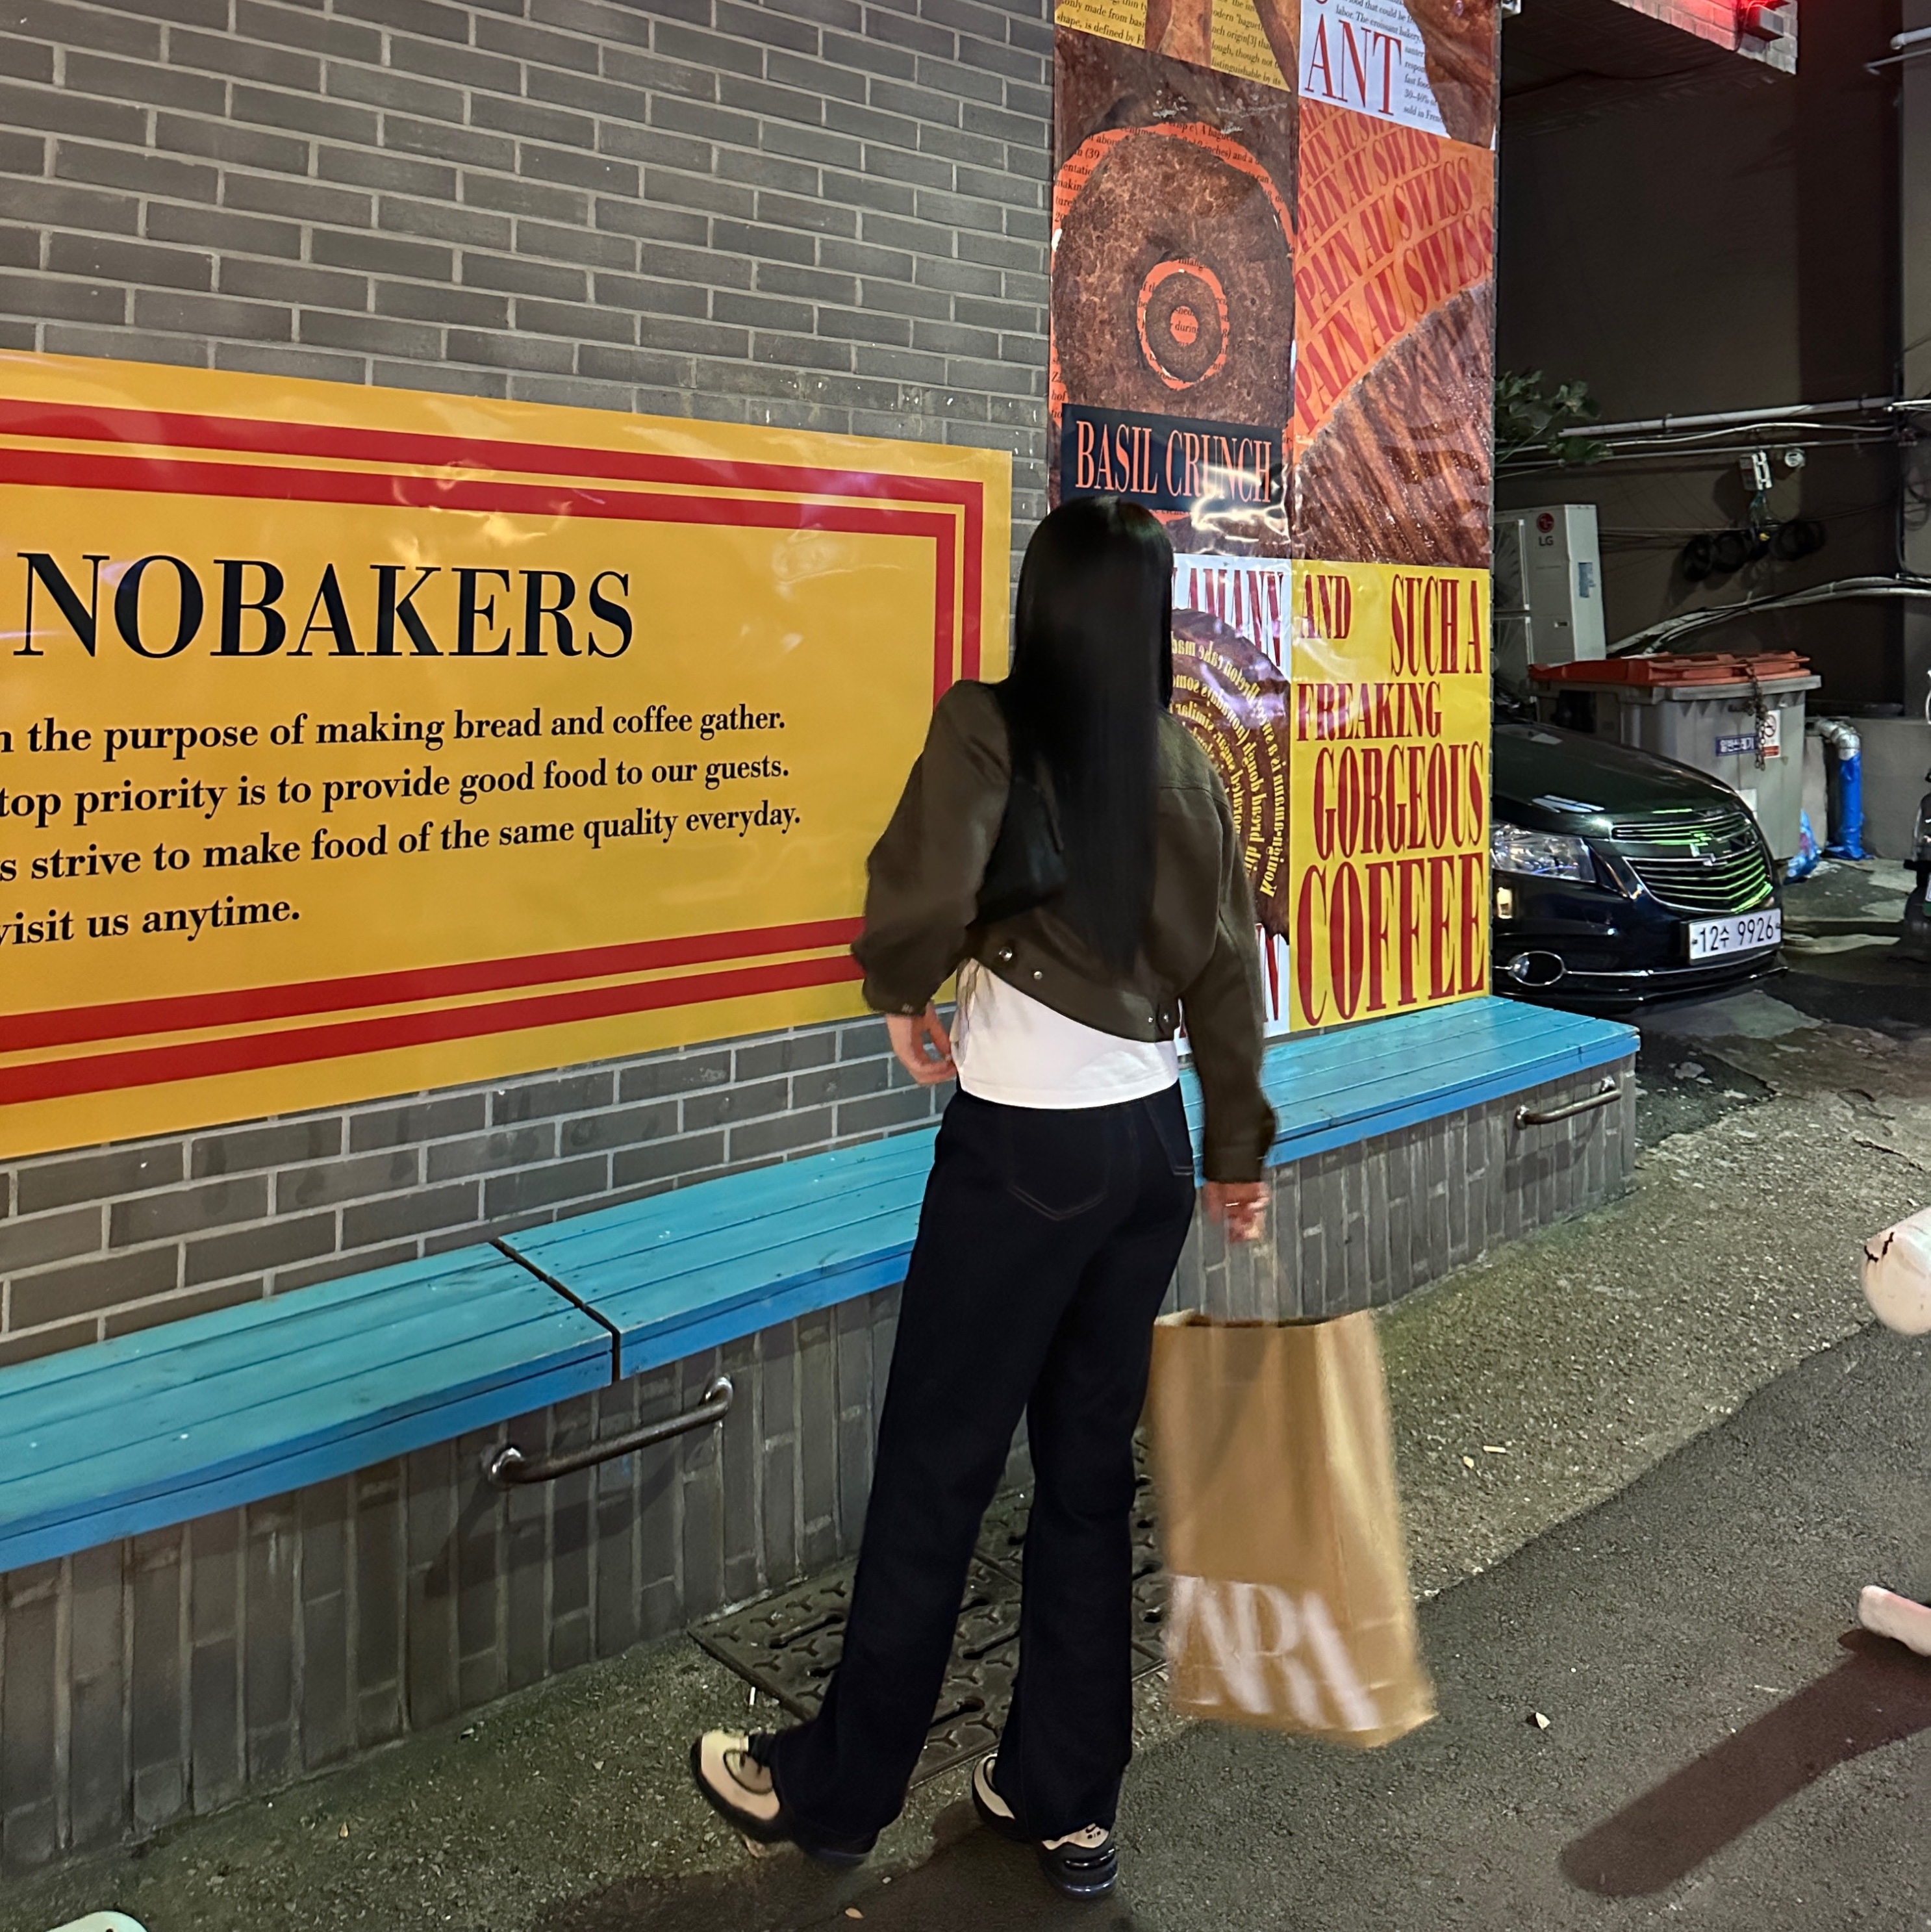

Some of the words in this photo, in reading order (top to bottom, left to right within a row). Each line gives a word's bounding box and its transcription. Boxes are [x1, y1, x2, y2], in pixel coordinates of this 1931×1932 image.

[1085, 3, 1106, 16] made
[1109, 8, 1127, 23] from
[1085, 20, 1092, 30] is
[1094, 22, 1124, 40] defined
[1235, 47, 1260, 65] though
[1261, 58, 1274, 67] not
[1305, 14, 1401, 116] ANT
[1233, 152, 1248, 162] and
[1344, 149, 1372, 207] AU
[1294, 222, 1363, 330] PAIN
[1360, 196, 1395, 268] AU
[1393, 157, 1472, 240] SWISS
[1294, 301, 1369, 435] PAIN
[1364, 261, 1407, 354] AU
[1076, 420, 1158, 494] BASIL
[1166, 429, 1272, 503] CRUNCH
[1539, 536, 1554, 546] LG
[14, 553, 632, 658] NOBAKERS
[1299, 575, 1352, 639] AND
[1391, 574, 1459, 677] SUCH
[1465, 580, 1483, 674] A
[28, 718, 91, 752] the
[104, 727, 257, 761] purpose
[271, 713, 307, 744] of
[316, 712, 444, 750] making
[454, 708, 541, 738] bread
[551, 707, 603, 735] and
[613, 705, 692, 733] coffee
[701, 704, 784, 740] gather.
[1296, 681, 1441, 741] FREAKING
[0, 788, 60, 828] top
[74, 778, 227, 826] priority
[238, 776, 265, 805] is
[278, 778, 310, 803] to
[323, 766, 449, 812] provide
[461, 761, 534, 804] good
[544, 758, 607, 789] food
[616, 762, 642, 785] to
[652, 765, 697, 782] our
[705, 756, 788, 789] guests.
[1314, 741, 1483, 861] GORGEOUS
[32, 845, 140, 878] strive
[154, 844, 189, 871] to
[204, 832, 299, 867] make
[312, 825, 387, 859] food
[399, 822, 433, 852] of
[442, 820, 488, 850] the
[500, 823, 574, 845] same
[584, 807, 678, 848] quality
[687, 800, 800, 837] everyday.
[87, 915, 128, 937] us
[143, 896, 299, 941] anytime.
[1297, 852, 1485, 1026] COFFEE
[1700, 926, 1729, 952] 12수
[1737, 915, 1774, 946] 9926
